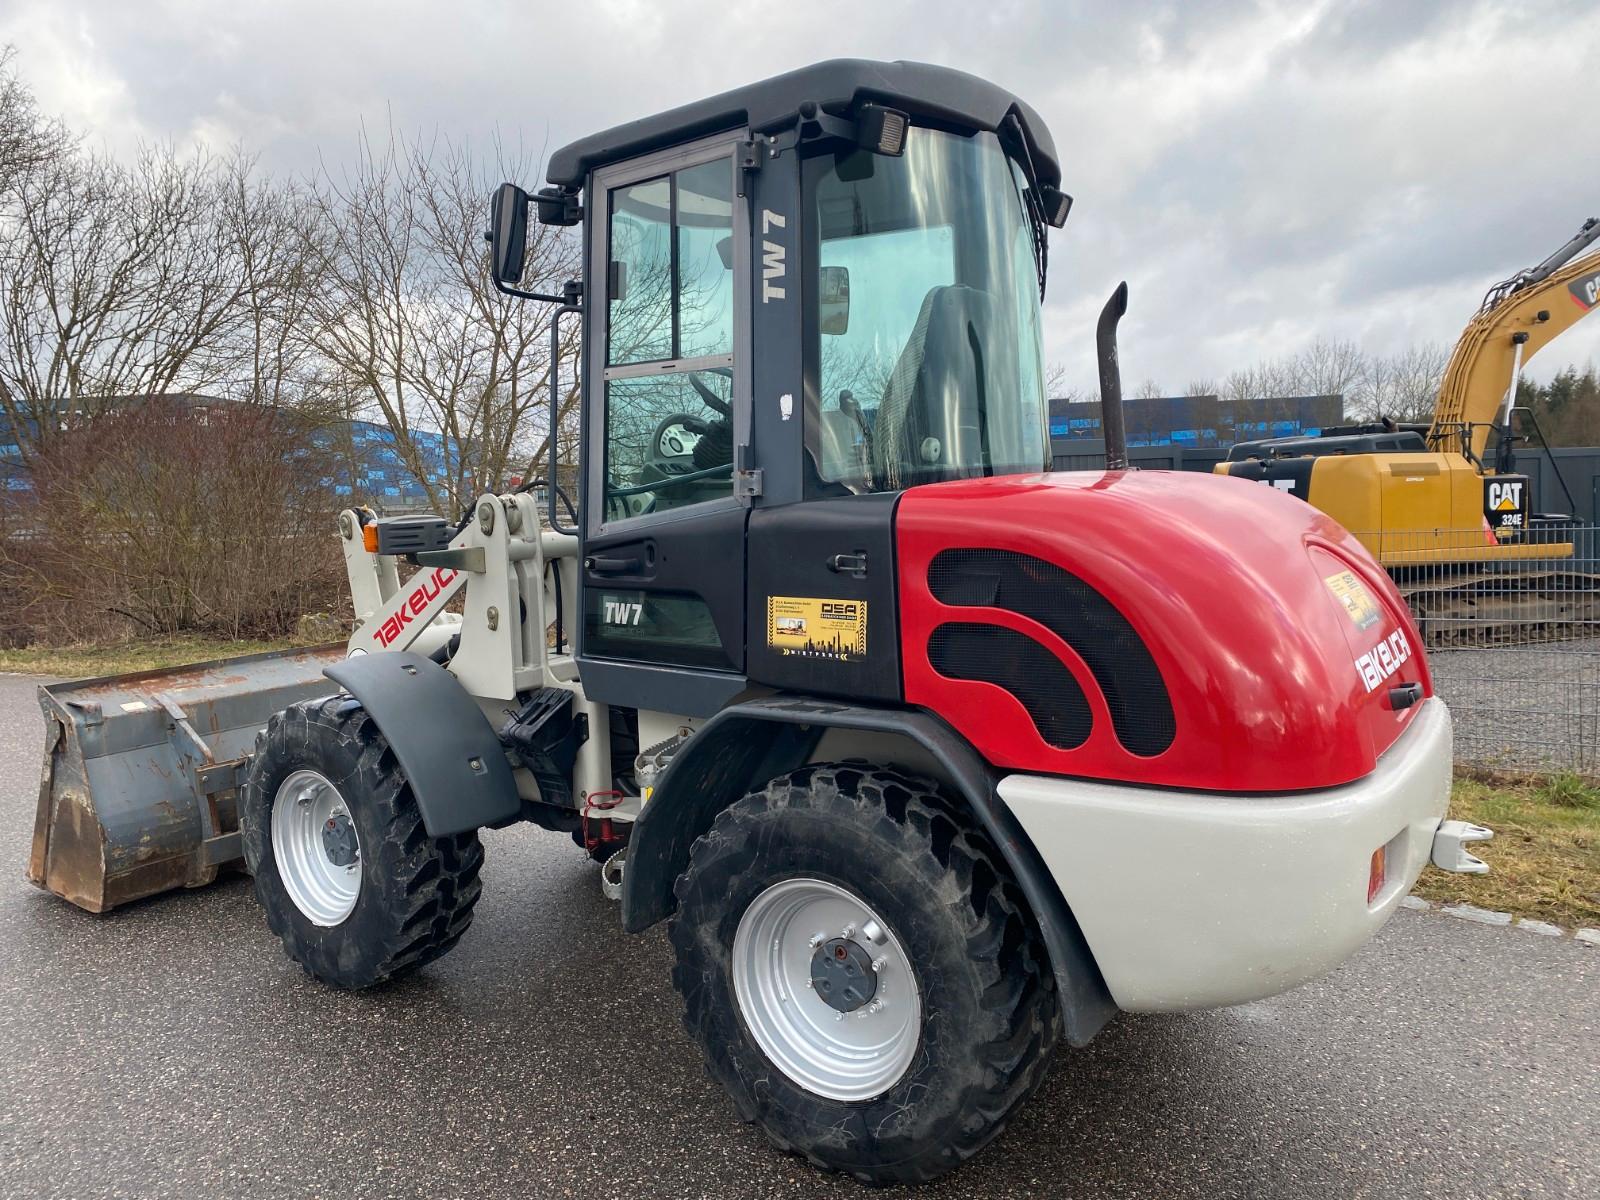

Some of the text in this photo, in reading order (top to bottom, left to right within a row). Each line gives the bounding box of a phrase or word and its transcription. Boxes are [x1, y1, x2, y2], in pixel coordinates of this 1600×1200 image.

[1489, 483, 1523, 511] CAT
[1502, 514, 1522, 526] 324E
[605, 602, 642, 626] TW7
